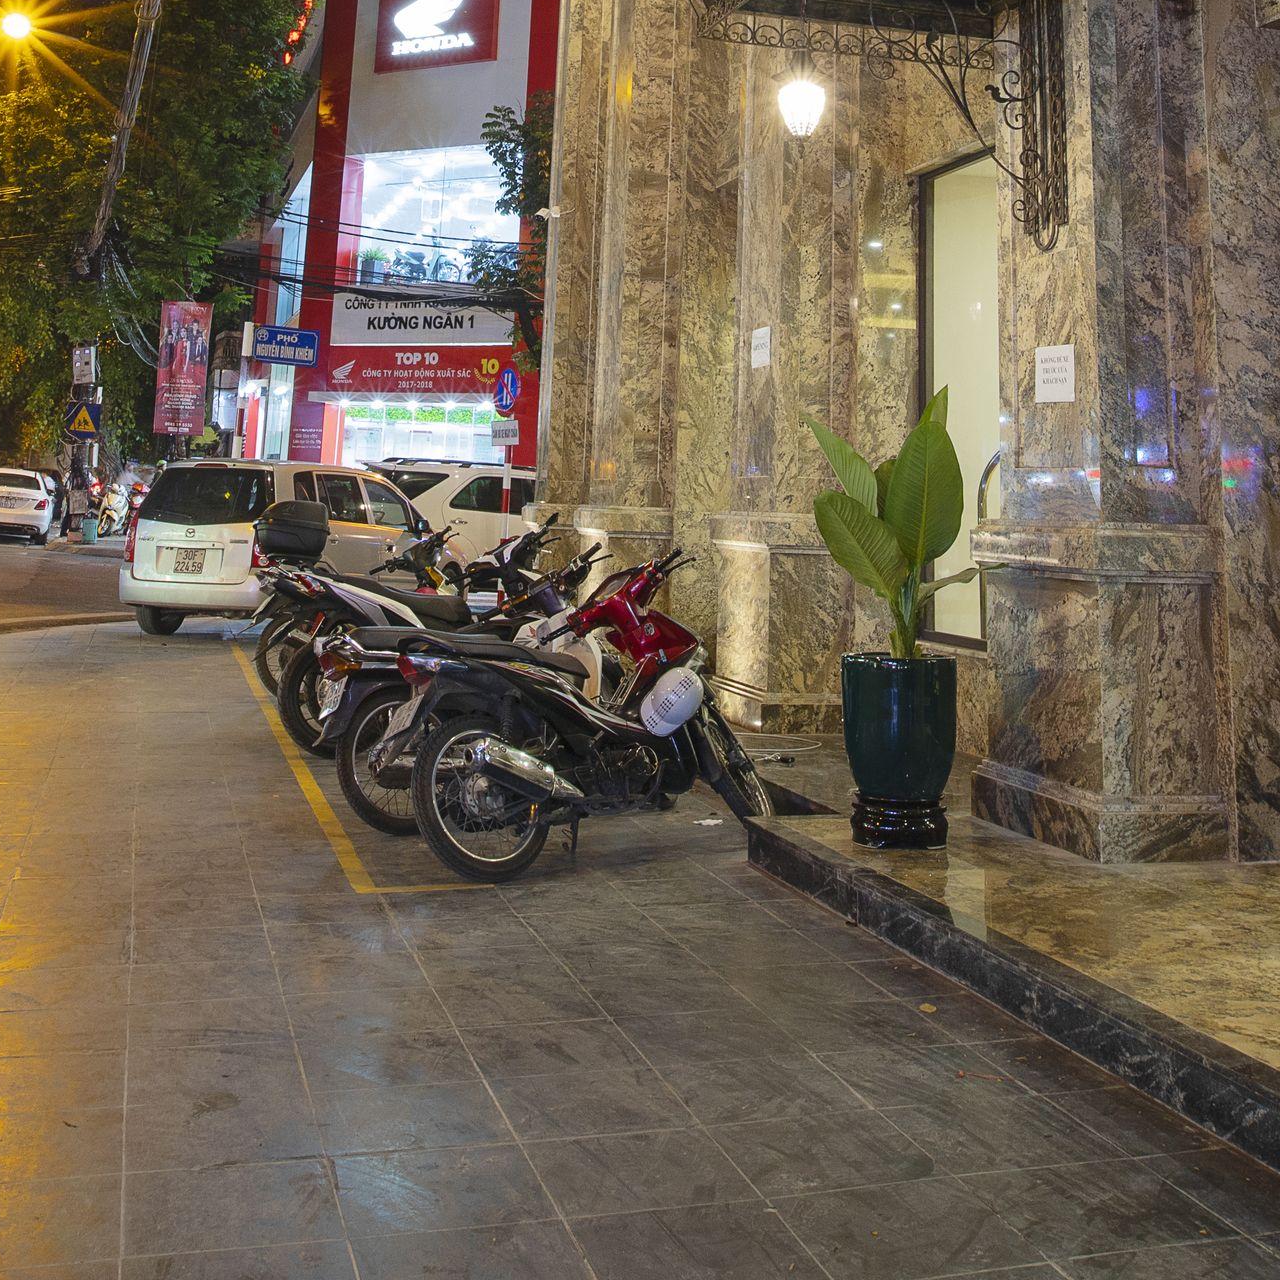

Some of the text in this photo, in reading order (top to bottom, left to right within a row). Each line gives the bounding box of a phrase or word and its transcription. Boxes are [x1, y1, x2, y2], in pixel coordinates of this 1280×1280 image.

[391, 32, 475, 56] HONDA
[345, 296, 375, 310] CÔNG
[367, 312, 475, 330] KƯỜNG NGÂN 1
[277, 333, 299, 343] PHỐ
[395, 352, 439, 365] TOP 10
[362, 368, 381, 377] CÔNG
[383, 369, 392, 377] TY
[394, 369, 412, 379] HOẠT
[414, 368, 435, 379] ĐỘNG
[436, 367, 455, 377] XUẤT
[481, 358, 500, 375] 10
[397, 380, 433, 389] 2017-2018
[182, 550, 198, 561] 30F
[174, 561, 203, 574] 224.59
